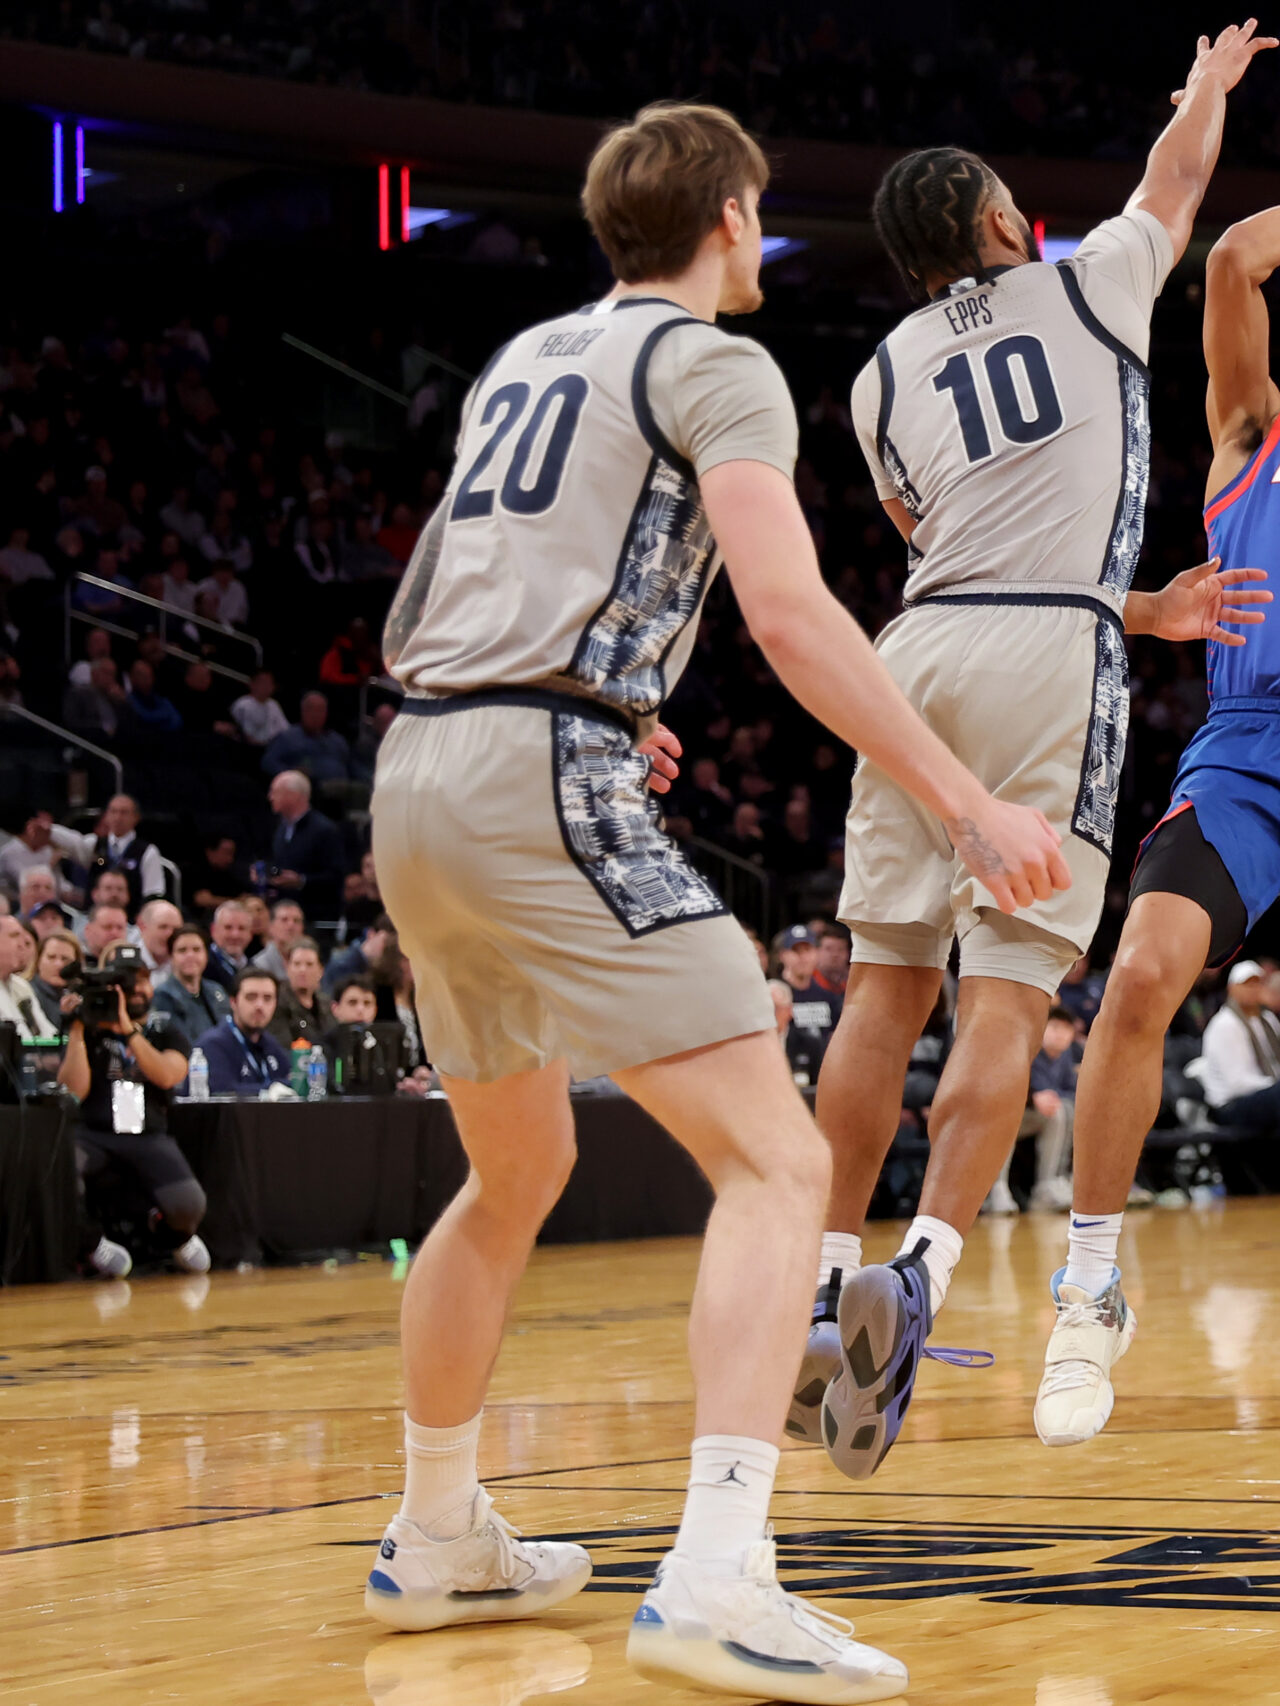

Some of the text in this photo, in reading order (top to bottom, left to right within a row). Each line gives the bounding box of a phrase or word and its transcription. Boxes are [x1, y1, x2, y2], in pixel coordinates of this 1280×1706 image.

[535, 328, 606, 359] FIELDER
[944, 294, 993, 336] EPPS
[931, 333, 1065, 465] 10
[449, 371, 590, 523] 20
